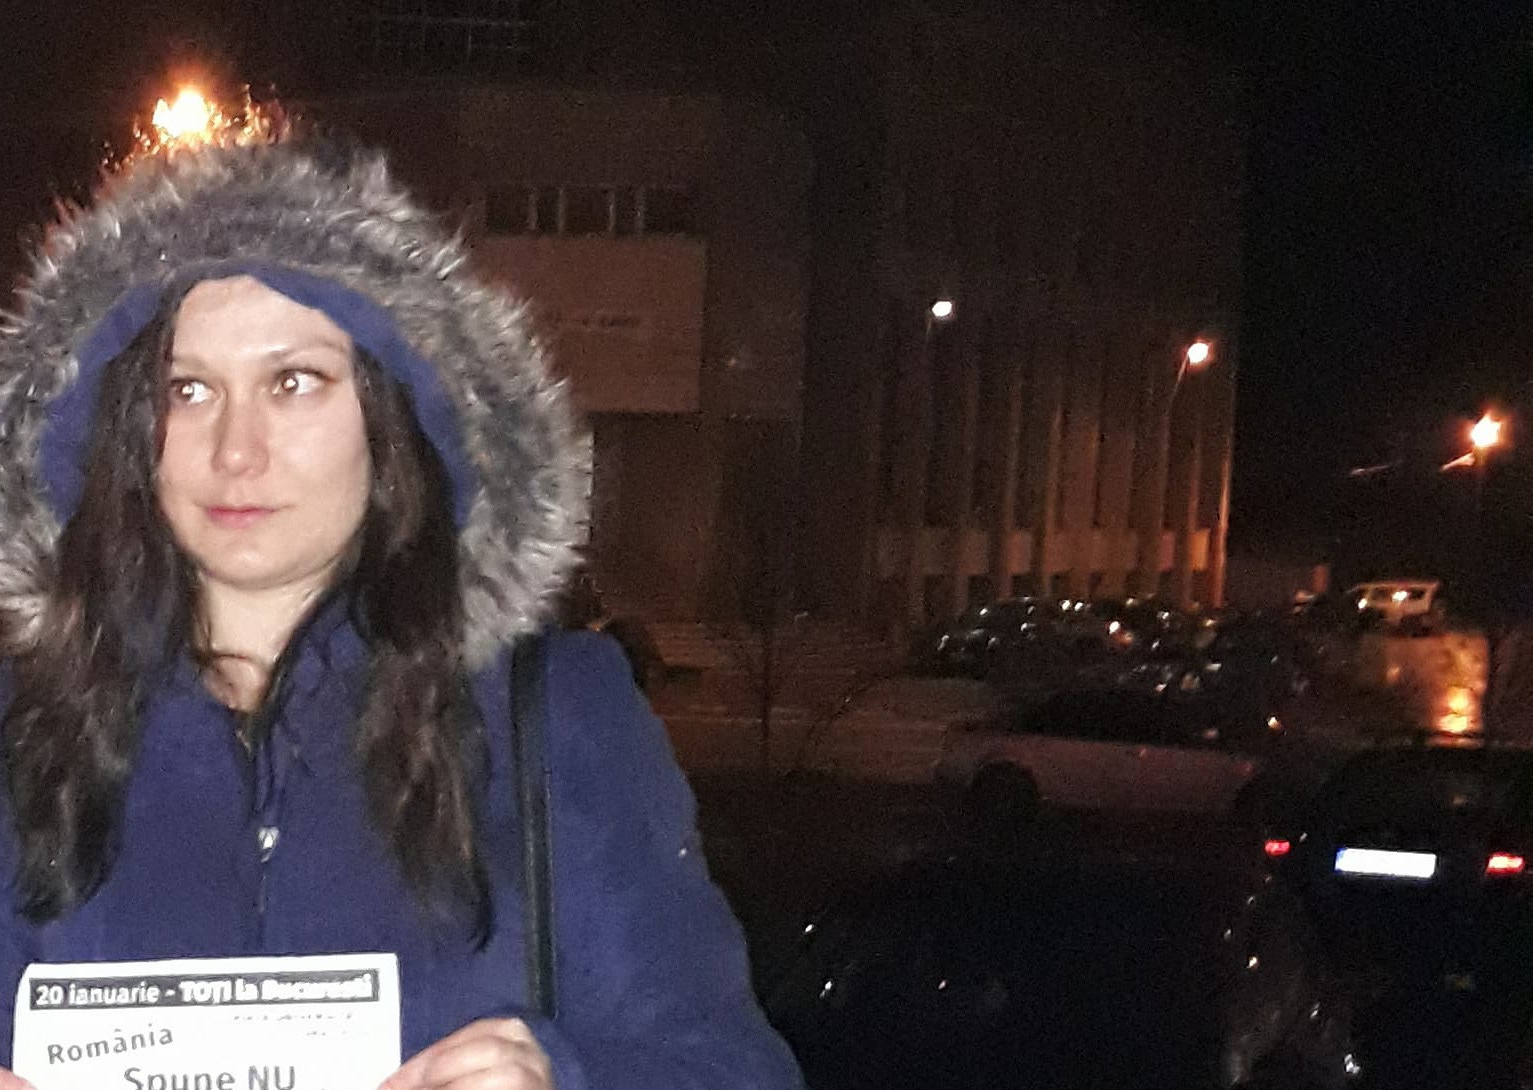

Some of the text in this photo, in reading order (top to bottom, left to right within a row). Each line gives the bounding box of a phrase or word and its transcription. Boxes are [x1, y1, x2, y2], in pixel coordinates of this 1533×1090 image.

[35, 984, 65, 1006] 20
[68, 980, 161, 1005] ianuarie
[46, 1022, 175, 1065] România
